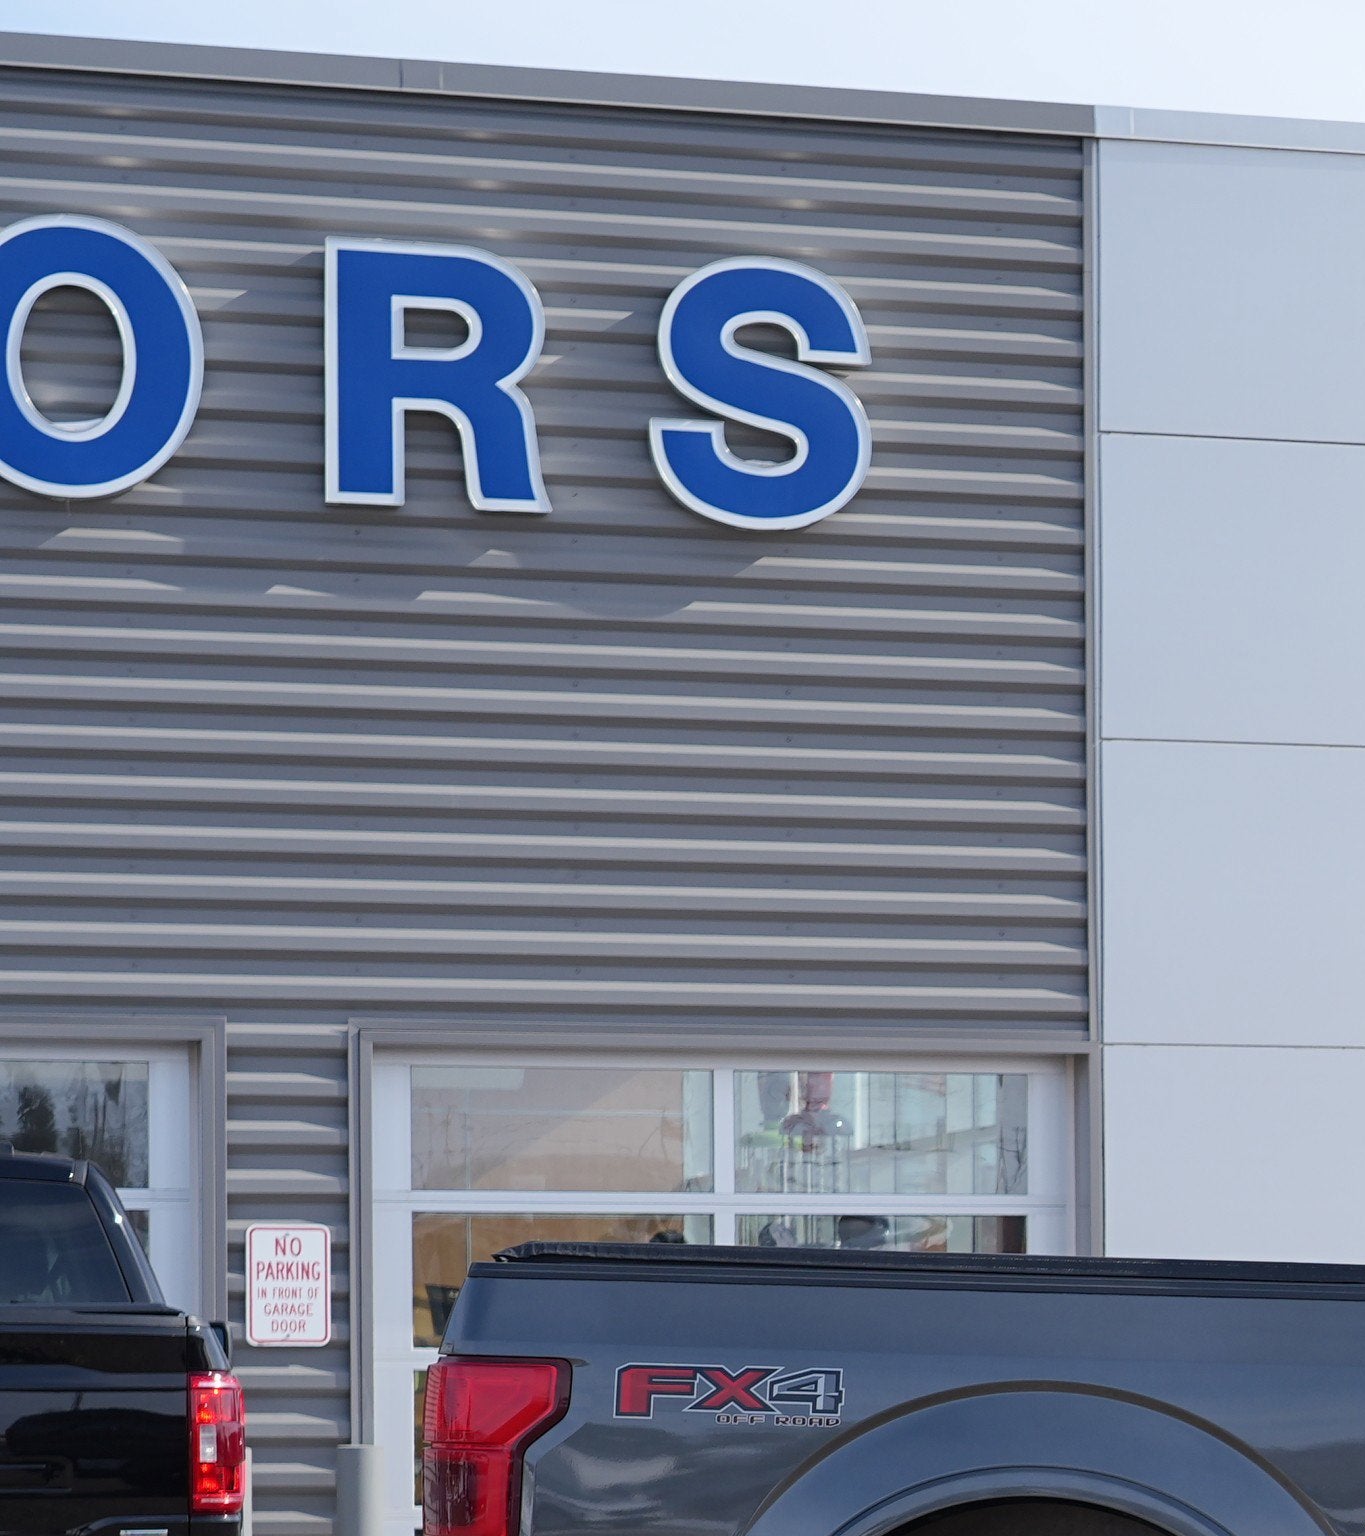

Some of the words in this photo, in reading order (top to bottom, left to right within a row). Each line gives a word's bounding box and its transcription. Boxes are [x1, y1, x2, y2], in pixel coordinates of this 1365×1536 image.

[0, 213, 872, 531] ORS
[274, 1237, 302, 1257] NO
[256, 1261, 321, 1281] PARKING
[257, 1286, 267, 1299] IN
[272, 1286, 302, 1299] FRONT
[307, 1286, 320, 1299] OF
[263, 1303, 313, 1317] GARAGE
[271, 1319, 306, 1333] DOOR
[613, 1362, 845, 1419] FX4
[715, 1413, 766, 1425] OFF
[774, 1415, 841, 1428] ROAD
